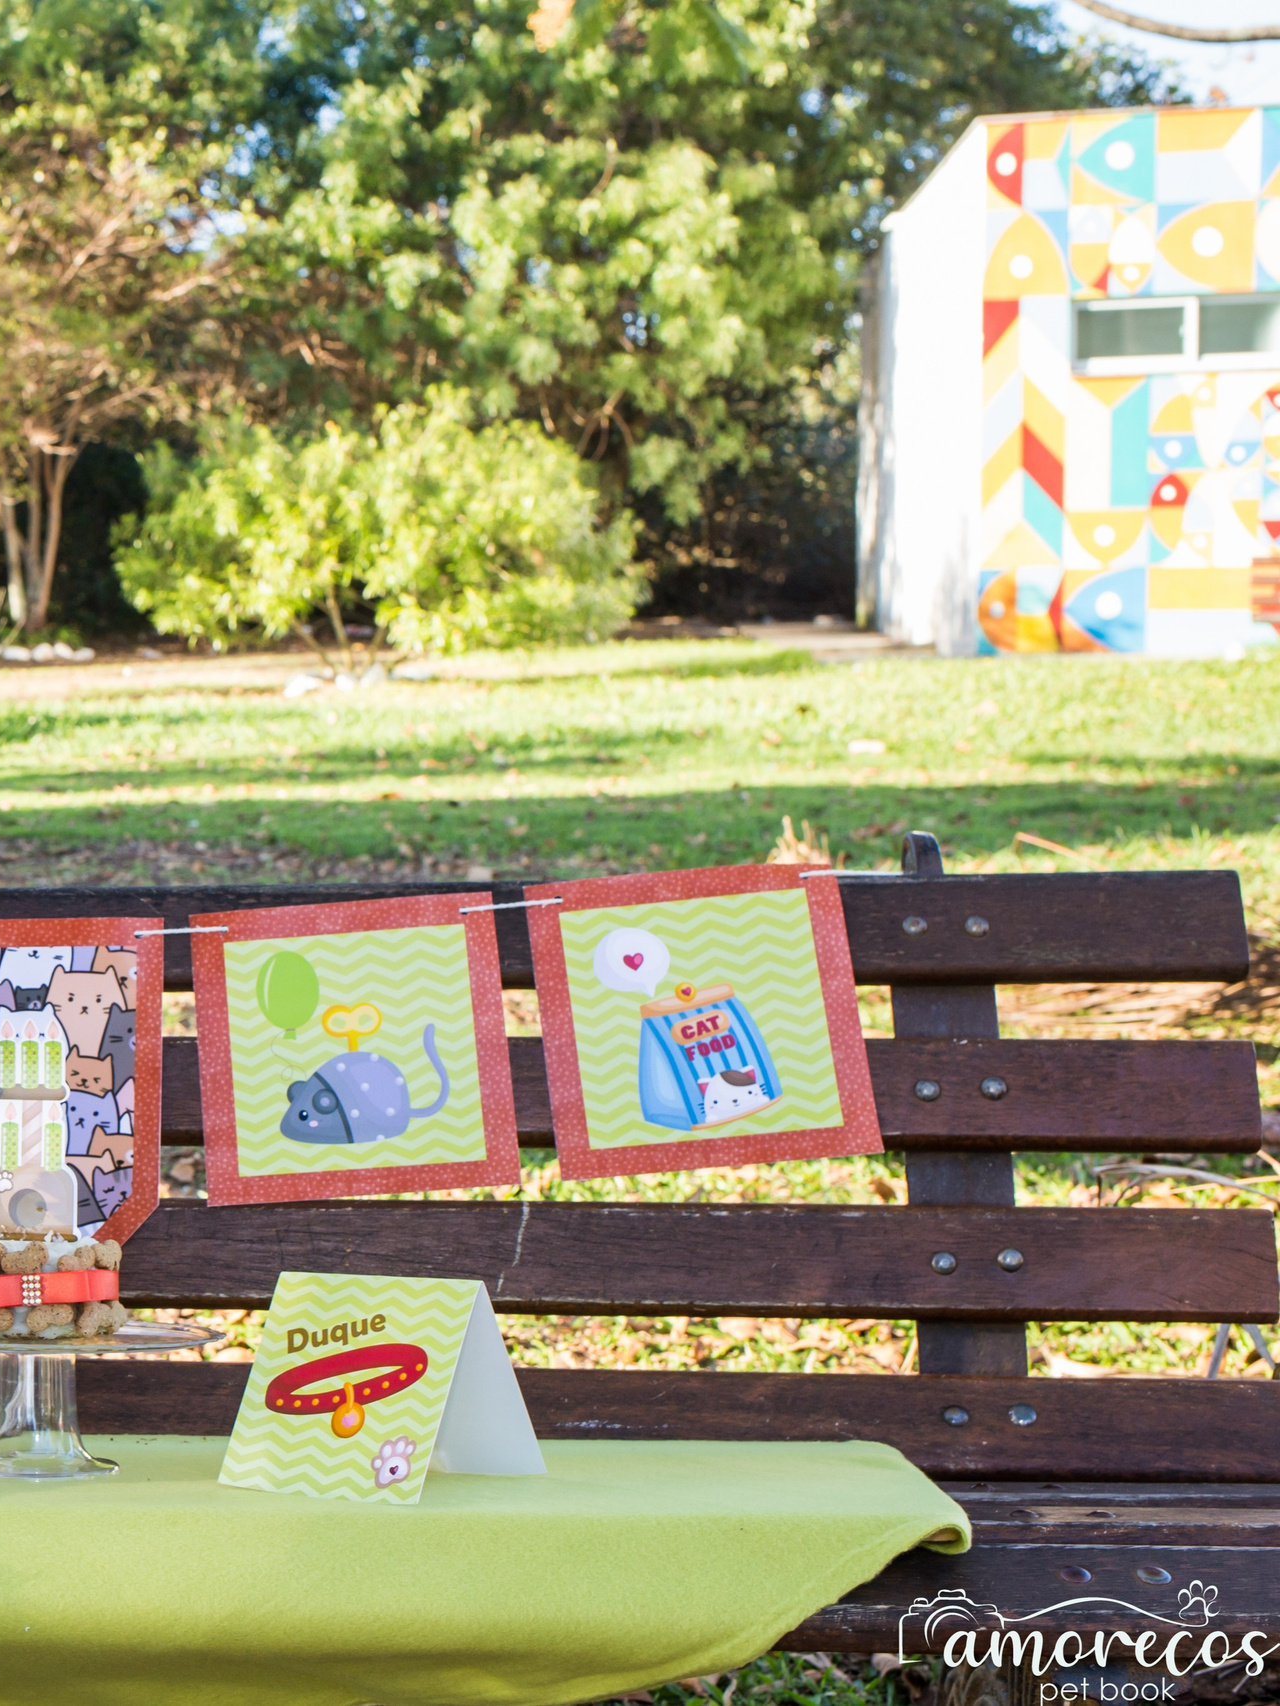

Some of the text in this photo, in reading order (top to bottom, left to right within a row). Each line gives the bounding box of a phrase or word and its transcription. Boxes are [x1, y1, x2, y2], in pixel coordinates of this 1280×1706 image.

[680, 1015, 720, 1040] CAT
[684, 1034, 736, 1062] FOOD
[287, 1313, 386, 1354] Duque
